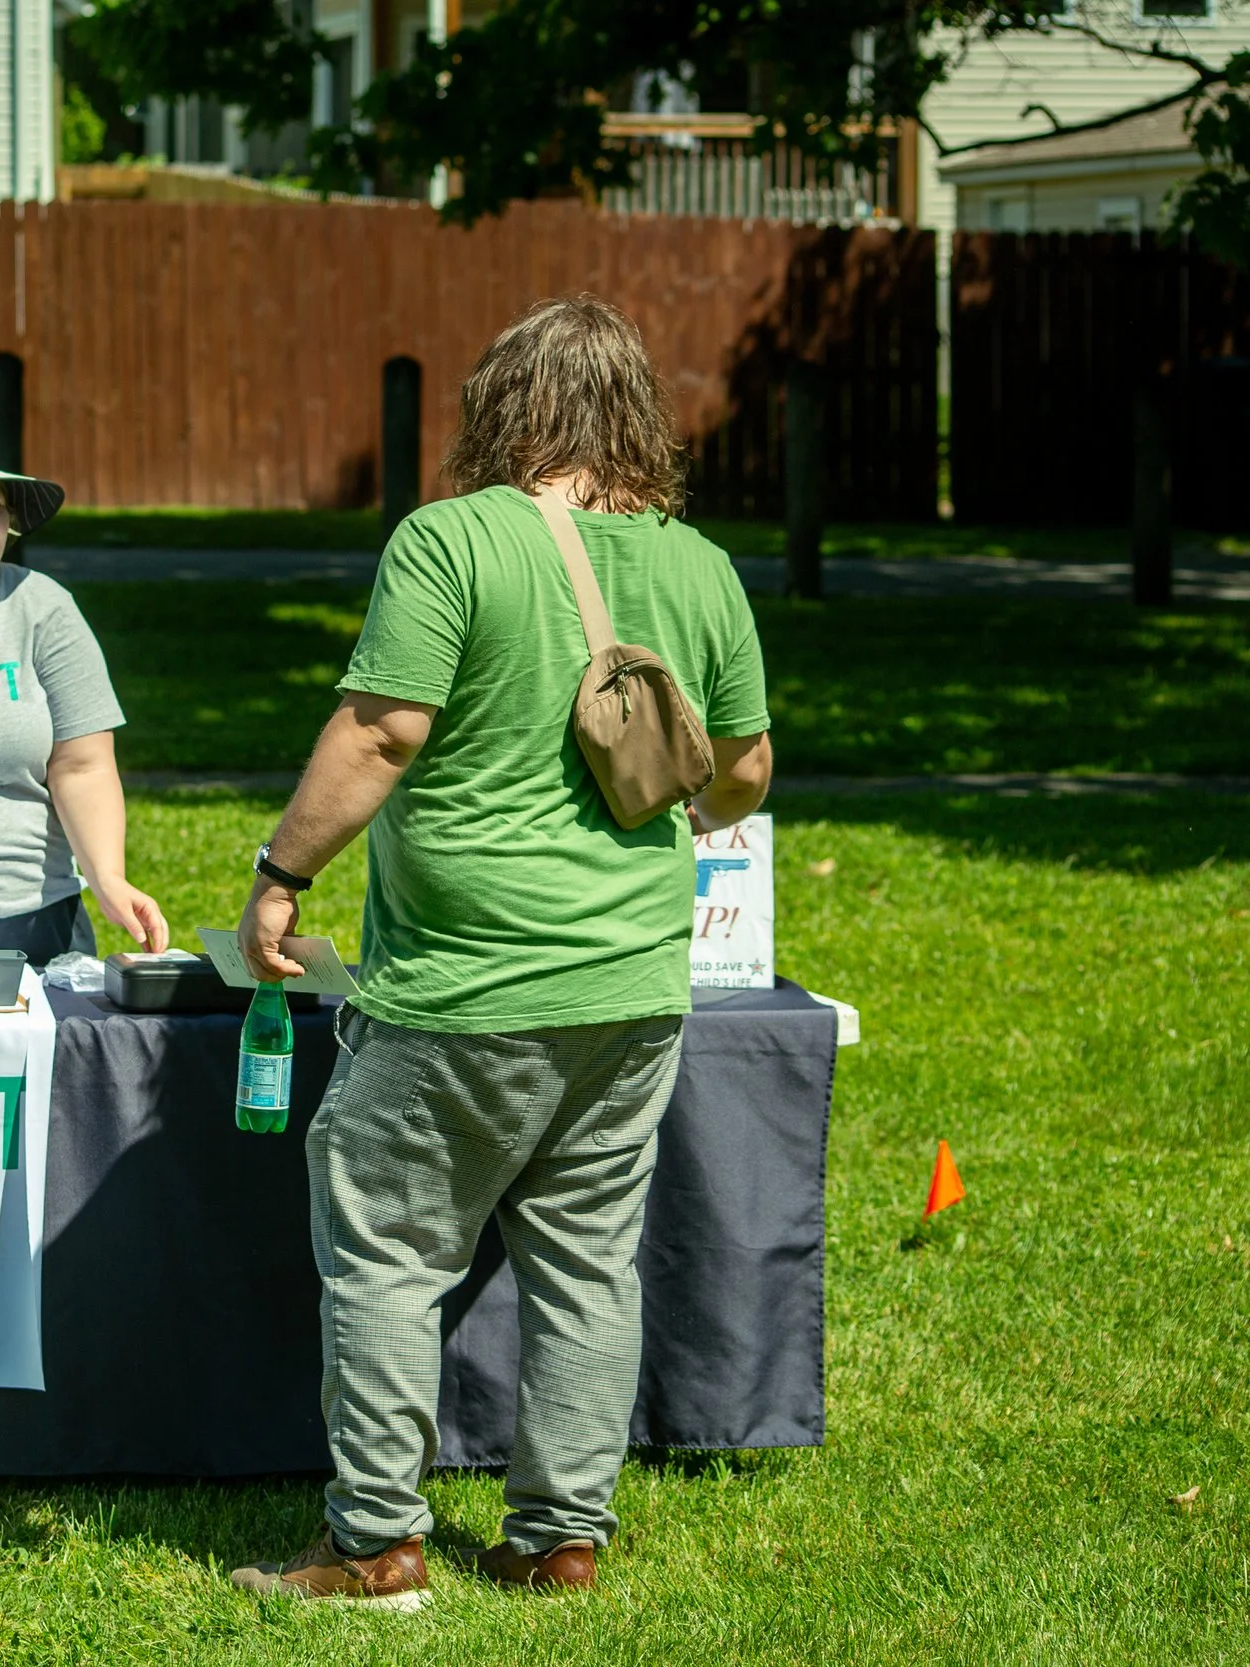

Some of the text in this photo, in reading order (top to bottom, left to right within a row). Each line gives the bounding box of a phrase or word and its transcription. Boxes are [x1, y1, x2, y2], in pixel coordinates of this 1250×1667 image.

[694, 906, 740, 939] P!
[715, 962, 743, 971] SAVE
[690, 977, 752, 988] HILD'S LIFE
